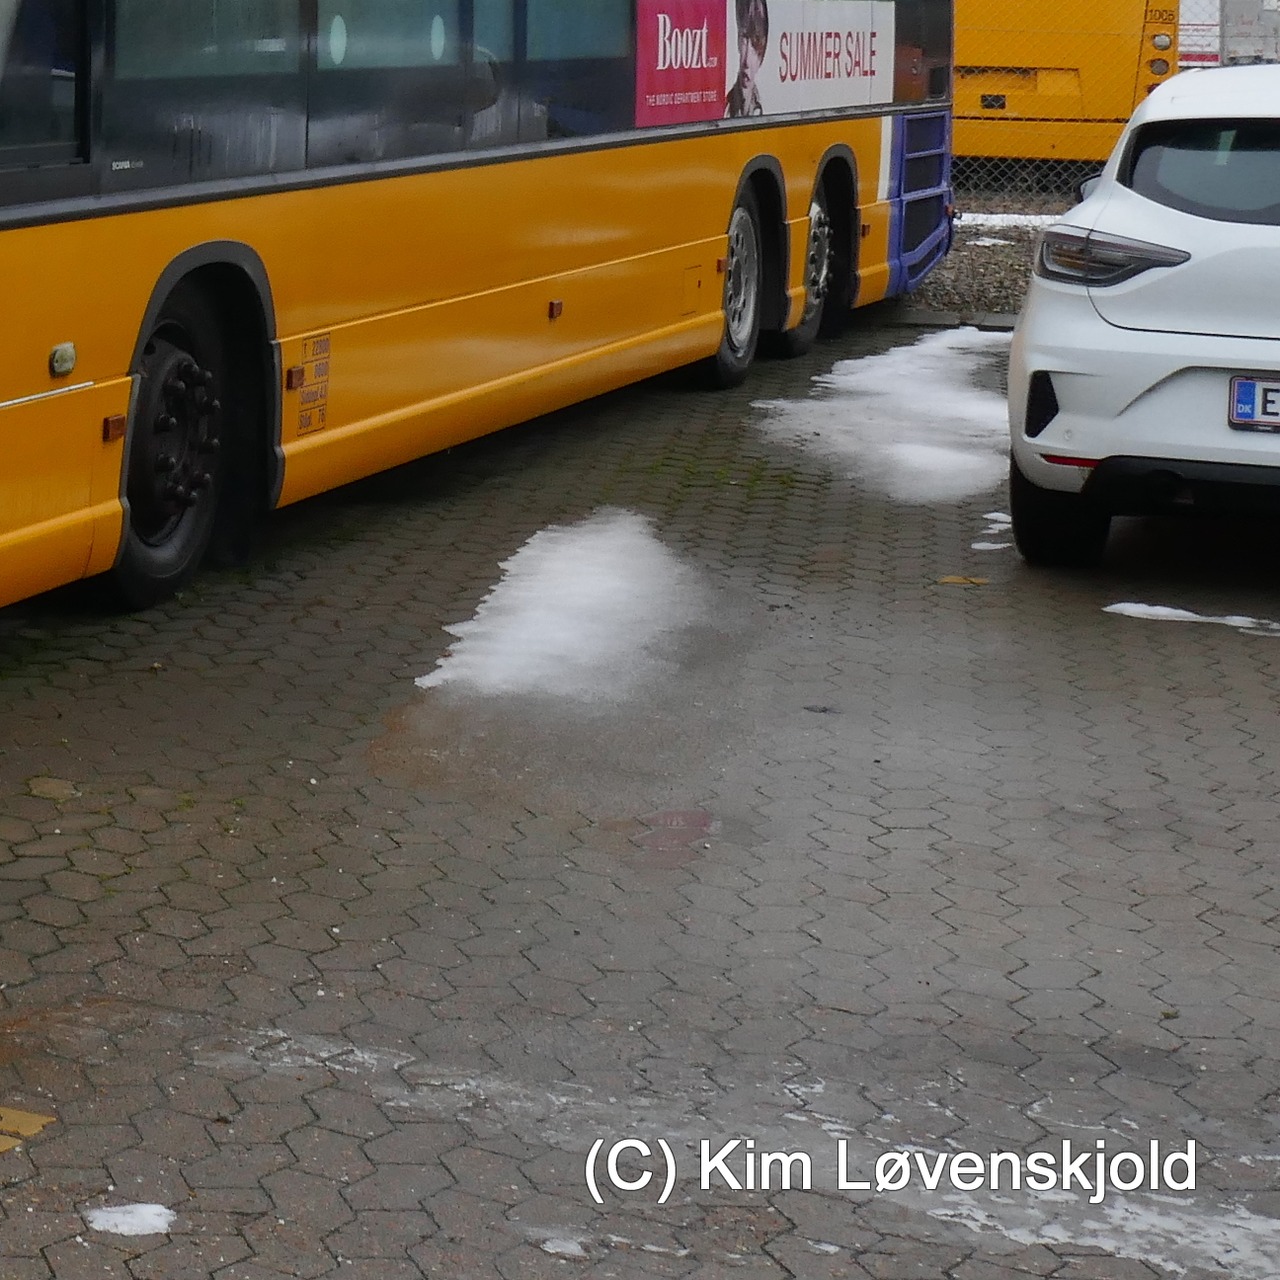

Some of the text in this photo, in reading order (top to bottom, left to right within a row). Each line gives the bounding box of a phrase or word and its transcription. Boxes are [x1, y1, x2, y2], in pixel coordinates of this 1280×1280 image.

[778, 30, 877, 83] SUMMER SALE
[1237, 404, 1252, 414] DK
